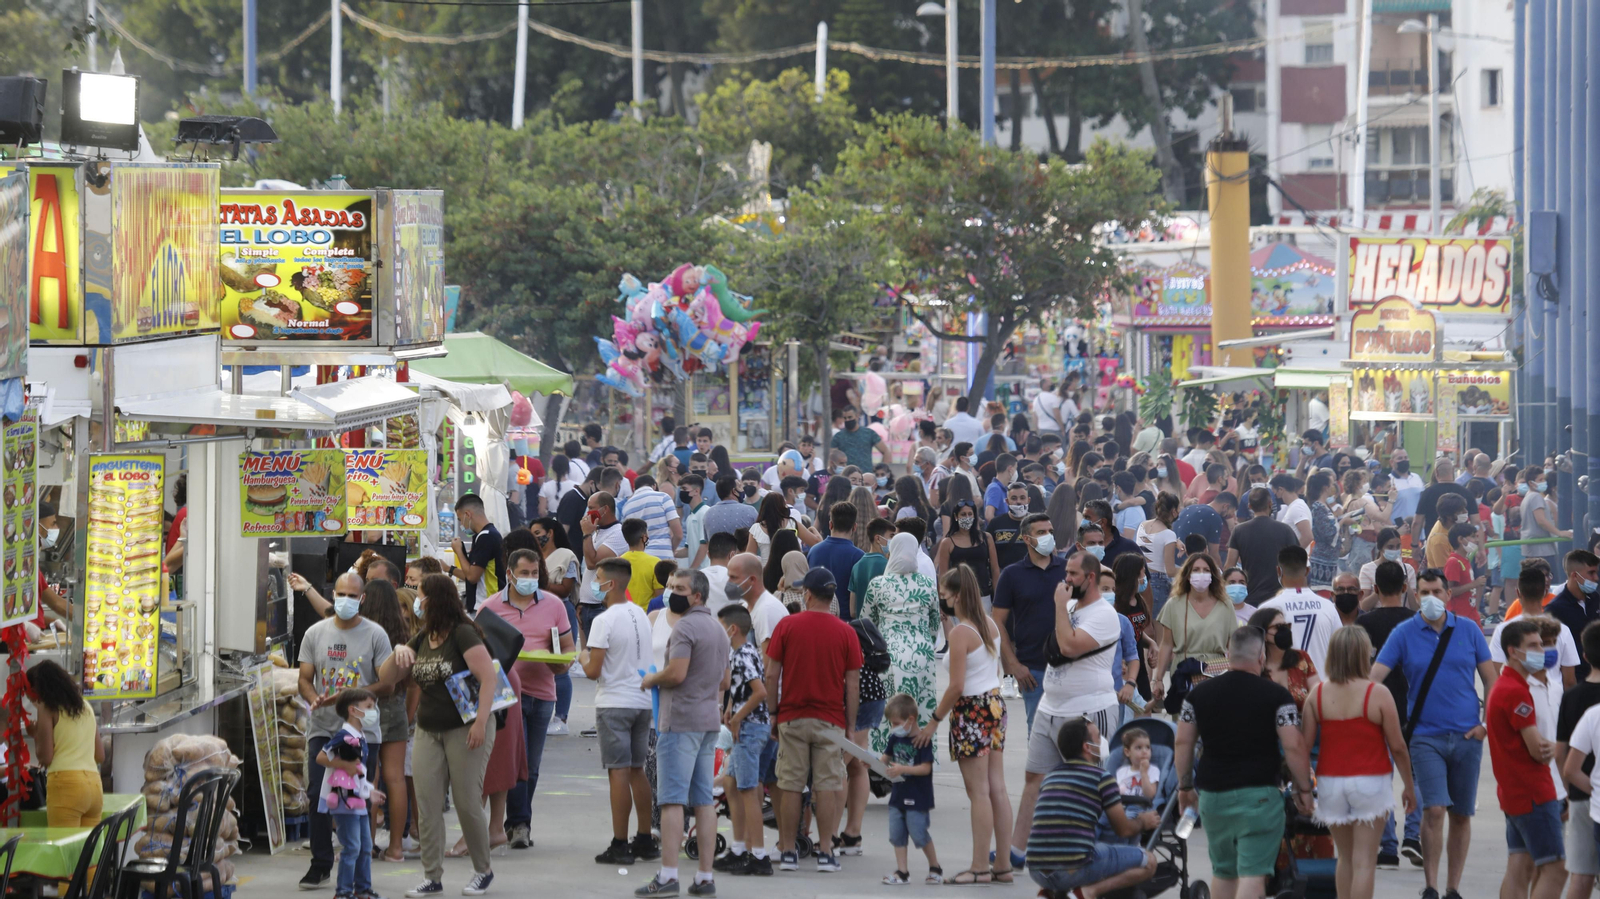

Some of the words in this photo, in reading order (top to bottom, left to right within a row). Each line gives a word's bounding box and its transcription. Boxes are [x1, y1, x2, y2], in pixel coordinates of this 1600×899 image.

[280, 199, 364, 228] ASADAS
[220, 229, 249, 244] EL
[254, 229, 331, 244] LOBO
[240, 247, 279, 258] Simple
[303, 247, 355, 258] Completa
[1351, 243, 1509, 305] HELADOS
[287, 319, 330, 328] Normal
[1355, 325, 1431, 354] BUÑUELOS
[1448, 374, 1502, 384] Buñuelos
[92, 460, 162, 472] BAGUETTERIA
[243, 452, 301, 472] MENÚ
[104, 472, 116, 481] EL
[118, 472, 150, 481] LOBO
[243, 473, 297, 487] Hamburguesa
[346, 471, 369, 481] rito
[290, 497, 309, 506] Patatas
[372, 492, 390, 500] Patatas
[243, 521, 281, 532] Refresco
[1285, 600, 1322, 611] HAZARD
[1293, 613, 1317, 652] 7
[334, 643, 347, 651] BEER
[327, 650, 347, 658] BAND
